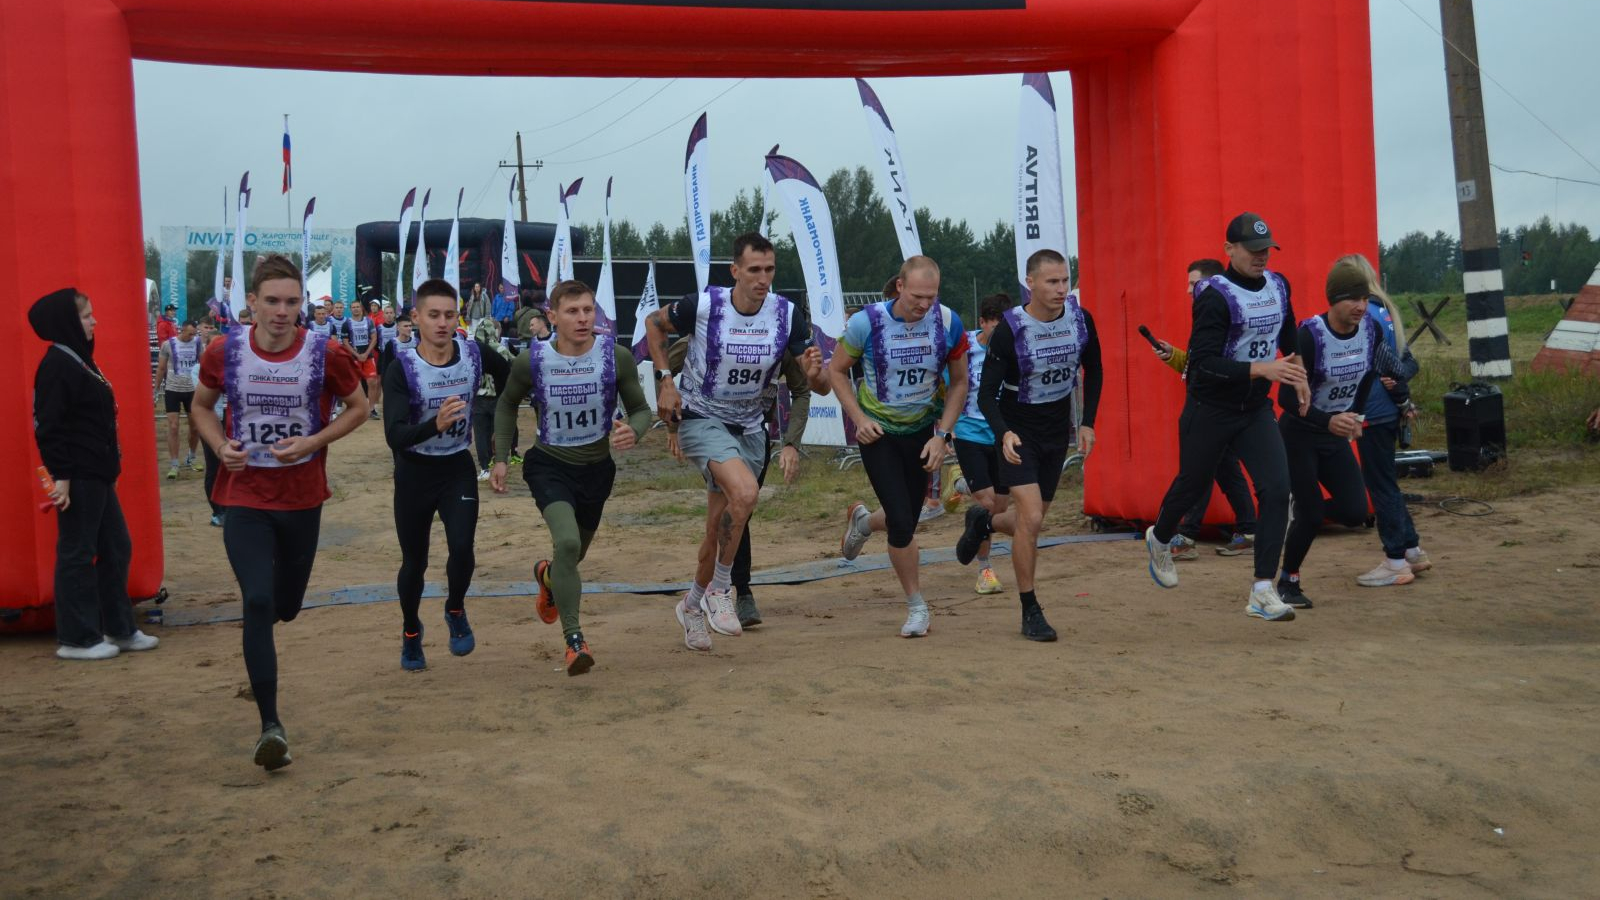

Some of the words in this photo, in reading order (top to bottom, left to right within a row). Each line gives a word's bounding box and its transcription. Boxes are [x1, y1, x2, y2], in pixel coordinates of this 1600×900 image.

[692, 163, 707, 242] ГАЗПРОМБАНК
[187, 231, 258, 246] INVITO
[728, 345, 769, 354] МАССОВЫЙ
[892, 347, 931, 358] МАССОВЫЙ
[1037, 345, 1075, 358] МАССОВЫЙ
[738, 355, 759, 363] СТАРТ
[1047, 356, 1067, 364] СТАРТ
[1332, 363, 1364, 375] МАССОВЫЙ
[727, 368, 762, 385] 894
[897, 369, 927, 386] 767
[1041, 368, 1071, 385] 820
[551, 384, 596, 396] МАССОВЫЙ
[1328, 384, 1357, 400] 882
[248, 395, 300, 406] МАССОВЫЙ
[562, 396, 586, 404] СТАРТ
[262, 406, 289, 416] СТАРТ
[809, 406, 837, 417] АЗПРОМБАНК
[553, 409, 597, 429] 1141
[248, 423, 302, 444] 1256
[437, 418, 466, 439] 42
